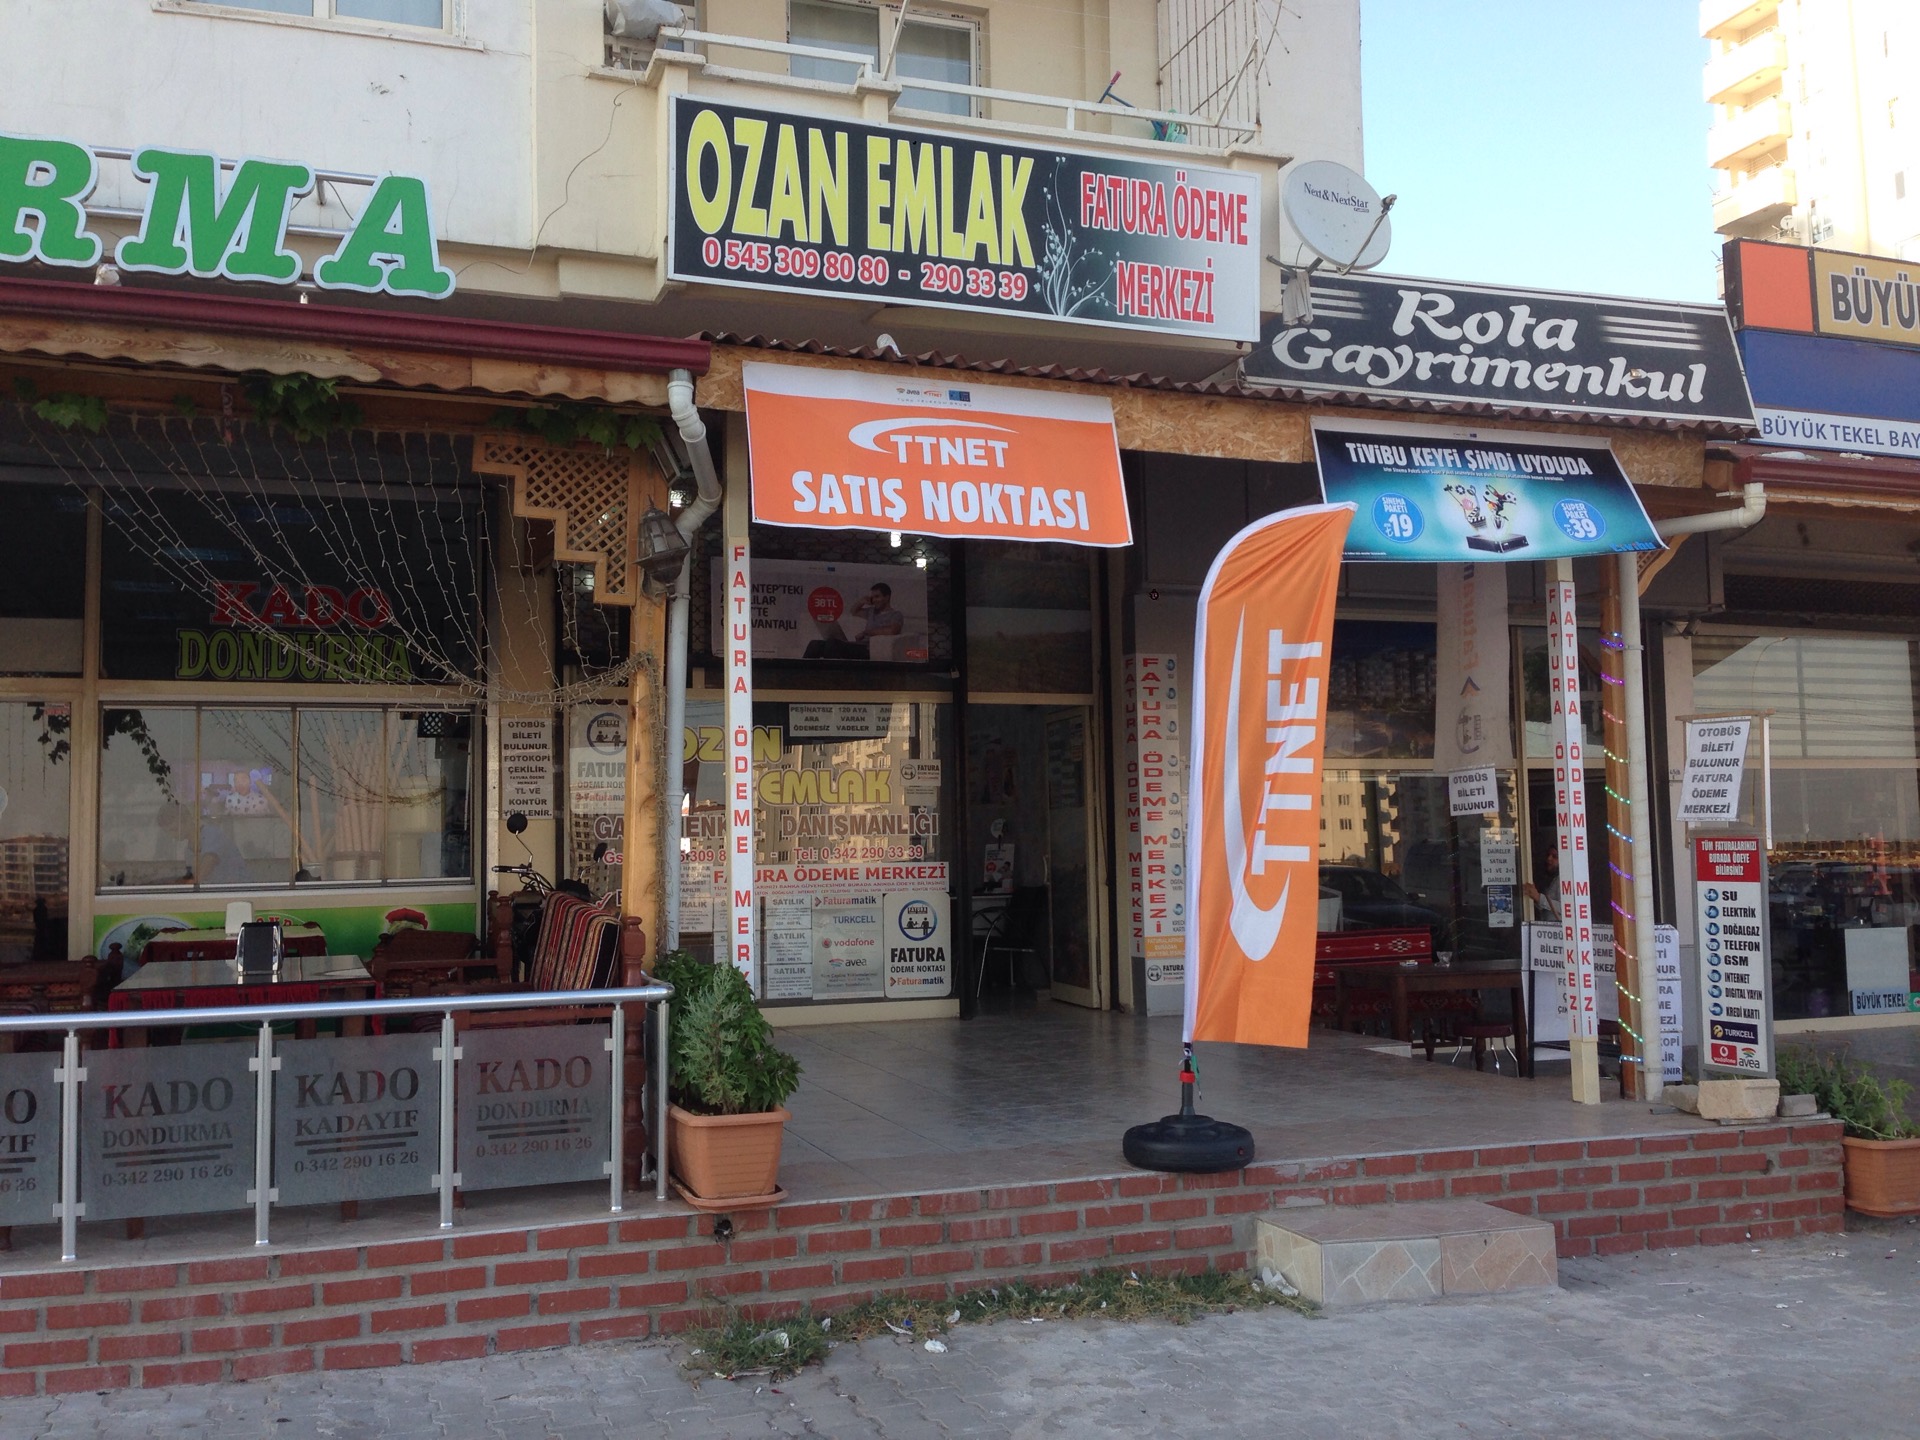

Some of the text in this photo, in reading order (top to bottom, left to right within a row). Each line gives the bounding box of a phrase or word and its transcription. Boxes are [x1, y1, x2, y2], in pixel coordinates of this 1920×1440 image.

[686, 109, 1035, 269] OZAN EMLAK
[1080, 170, 1248, 245] FATURA ÖDEME
[704, 237, 721, 268] 0
[725, 239, 770, 272] 545
[775, 245, 819, 277] 309
[823, 251, 855, 282] 80
[858, 255, 888, 286] 80
[921, 262, 963, 294] 290
[966, 267, 996, 297] 33
[998, 270, 1028, 301] 39
[1117, 259, 1215, 324] MERKEZİ
[1830, 266, 1920, 331] BÜYÜ
[1392, 289, 1579, 352] Rota
[1272, 327, 1707, 404] Gayrimenkul
[1762, 415, 1827, 441] BÜYÜK
[1830, 424, 1884, 446] TEKEL
[890, 435, 1009, 469] TTNET
[1521, 454, 1594, 476] UYDUDA
[791, 471, 1090, 531] SATIŞ NOKTASI
[210, 581, 392, 630] KADO
[814, 598, 826, 608] 38
[176, 628, 415, 682] DONDURMA
[1549, 589, 1562, 715] FATURA
[733, 546, 750, 854] FATURA ÖDEME
[1141, 658, 1162, 739] FATURA
[508, 721, 546, 729] OTOBÜS
[1698, 726, 1741, 738] OTOBÜS
[512, 731, 542, 739] BİLETİ
[1252, 629, 1323, 876] TTNET
[1701, 741, 1734, 752] BİLETİ
[504, 754, 550, 762] FOTOKOPİ
[1689, 757, 1740, 768] BULUNUR
[577, 762, 626, 778] FATUR
[1692, 773, 1733, 783] FATURA
[1143, 751, 1167, 822] ÖDEME
[1453, 772, 1488, 785] OTOBÜS
[515, 787, 541, 795] TL VE
[758, 769, 892, 805] EMLAK
[1457, 786, 1485, 797] BİLETİ
[1691, 787, 1728, 799] ÖDEME
[1555, 742, 1568, 850] ÖDEME
[1124, 658, 1143, 952] FATURA ÖDEME MERKEZİ
[1453, 800, 1495, 812] BULUNUR
[1564, 589, 1594, 1035] FATURA ÖDEME MERKEZİ
[1684, 802, 1731, 814] MERKEZİ
[782, 809, 938, 841] DANIŞMANLIĞI
[793, 846, 818, 860] Tel:
[861, 846, 884, 859] 290
[888, 845, 904, 858] 33
[907, 844, 924, 857] 39
[1709, 852, 1750, 863] BURADA ÖDEYE
[794, 862, 946, 882] ÖDEME MERKEZİ
[1715, 864, 1744, 876] BİLİRSİNİZ
[1143, 834, 1167, 934] MERKEZİ
[823, 896, 876, 905] Faturamatik
[1722, 891, 1738, 901] SU
[833, 915, 876, 924] TURKCELL
[1722, 906, 1756, 918] ELEKTRİK
[773, 932, 805, 940] SATILIK
[1537, 929, 1563, 939] OTOBÜ
[1723, 923, 1760, 937] DOĞALGAZ
[834, 938, 874, 947] vodafone
[1540, 943, 1564, 954] BİLET
[1723, 940, 1761, 952] TELEFON
[845, 958, 867, 967] avea
[890, 947, 945, 963] FATURA
[1561, 880, 1578, 1034] MERKEZİ
[1724, 955, 1749, 967] GSM
[774, 967, 806, 975] SATILIK
[890, 965, 946, 973] ÖDEME NOKTASI
[897, 976, 944, 986] Faturamatik
[1746, 989, 1762, 1000] YAYIN
[1856, 992, 1906, 1010] BÜYÜK TEKEL
[1726, 1006, 1760, 1020] KREDİ KARTI
[1725, 1028, 1756, 1039] TURKCELL
[1739, 1057, 1760, 1069] avea
[476, 1055, 593, 1095] KADO
[294, 1066, 419, 1109] KADO
[102, 1077, 233, 1120] KADO
[476, 1098, 592, 1123] DONDURMA
[295, 1109, 418, 1137] KADAYIF
[102, 1123, 233, 1149] DONDURMA
[523, 1140, 549, 1155] 290
[554, 1138, 571, 1151] 16
[575, 1136, 592, 1150] 26
[343, 1155, 372, 1170] 290
[379, 1152, 394, 1166] 16
[400, 1150, 419, 1165] 26
[153, 1167, 184, 1183] 290
[190, 1166, 209, 1180] 16
[213, 1164, 233, 1178] 26
[16, 1177, 36, 1191] 26
